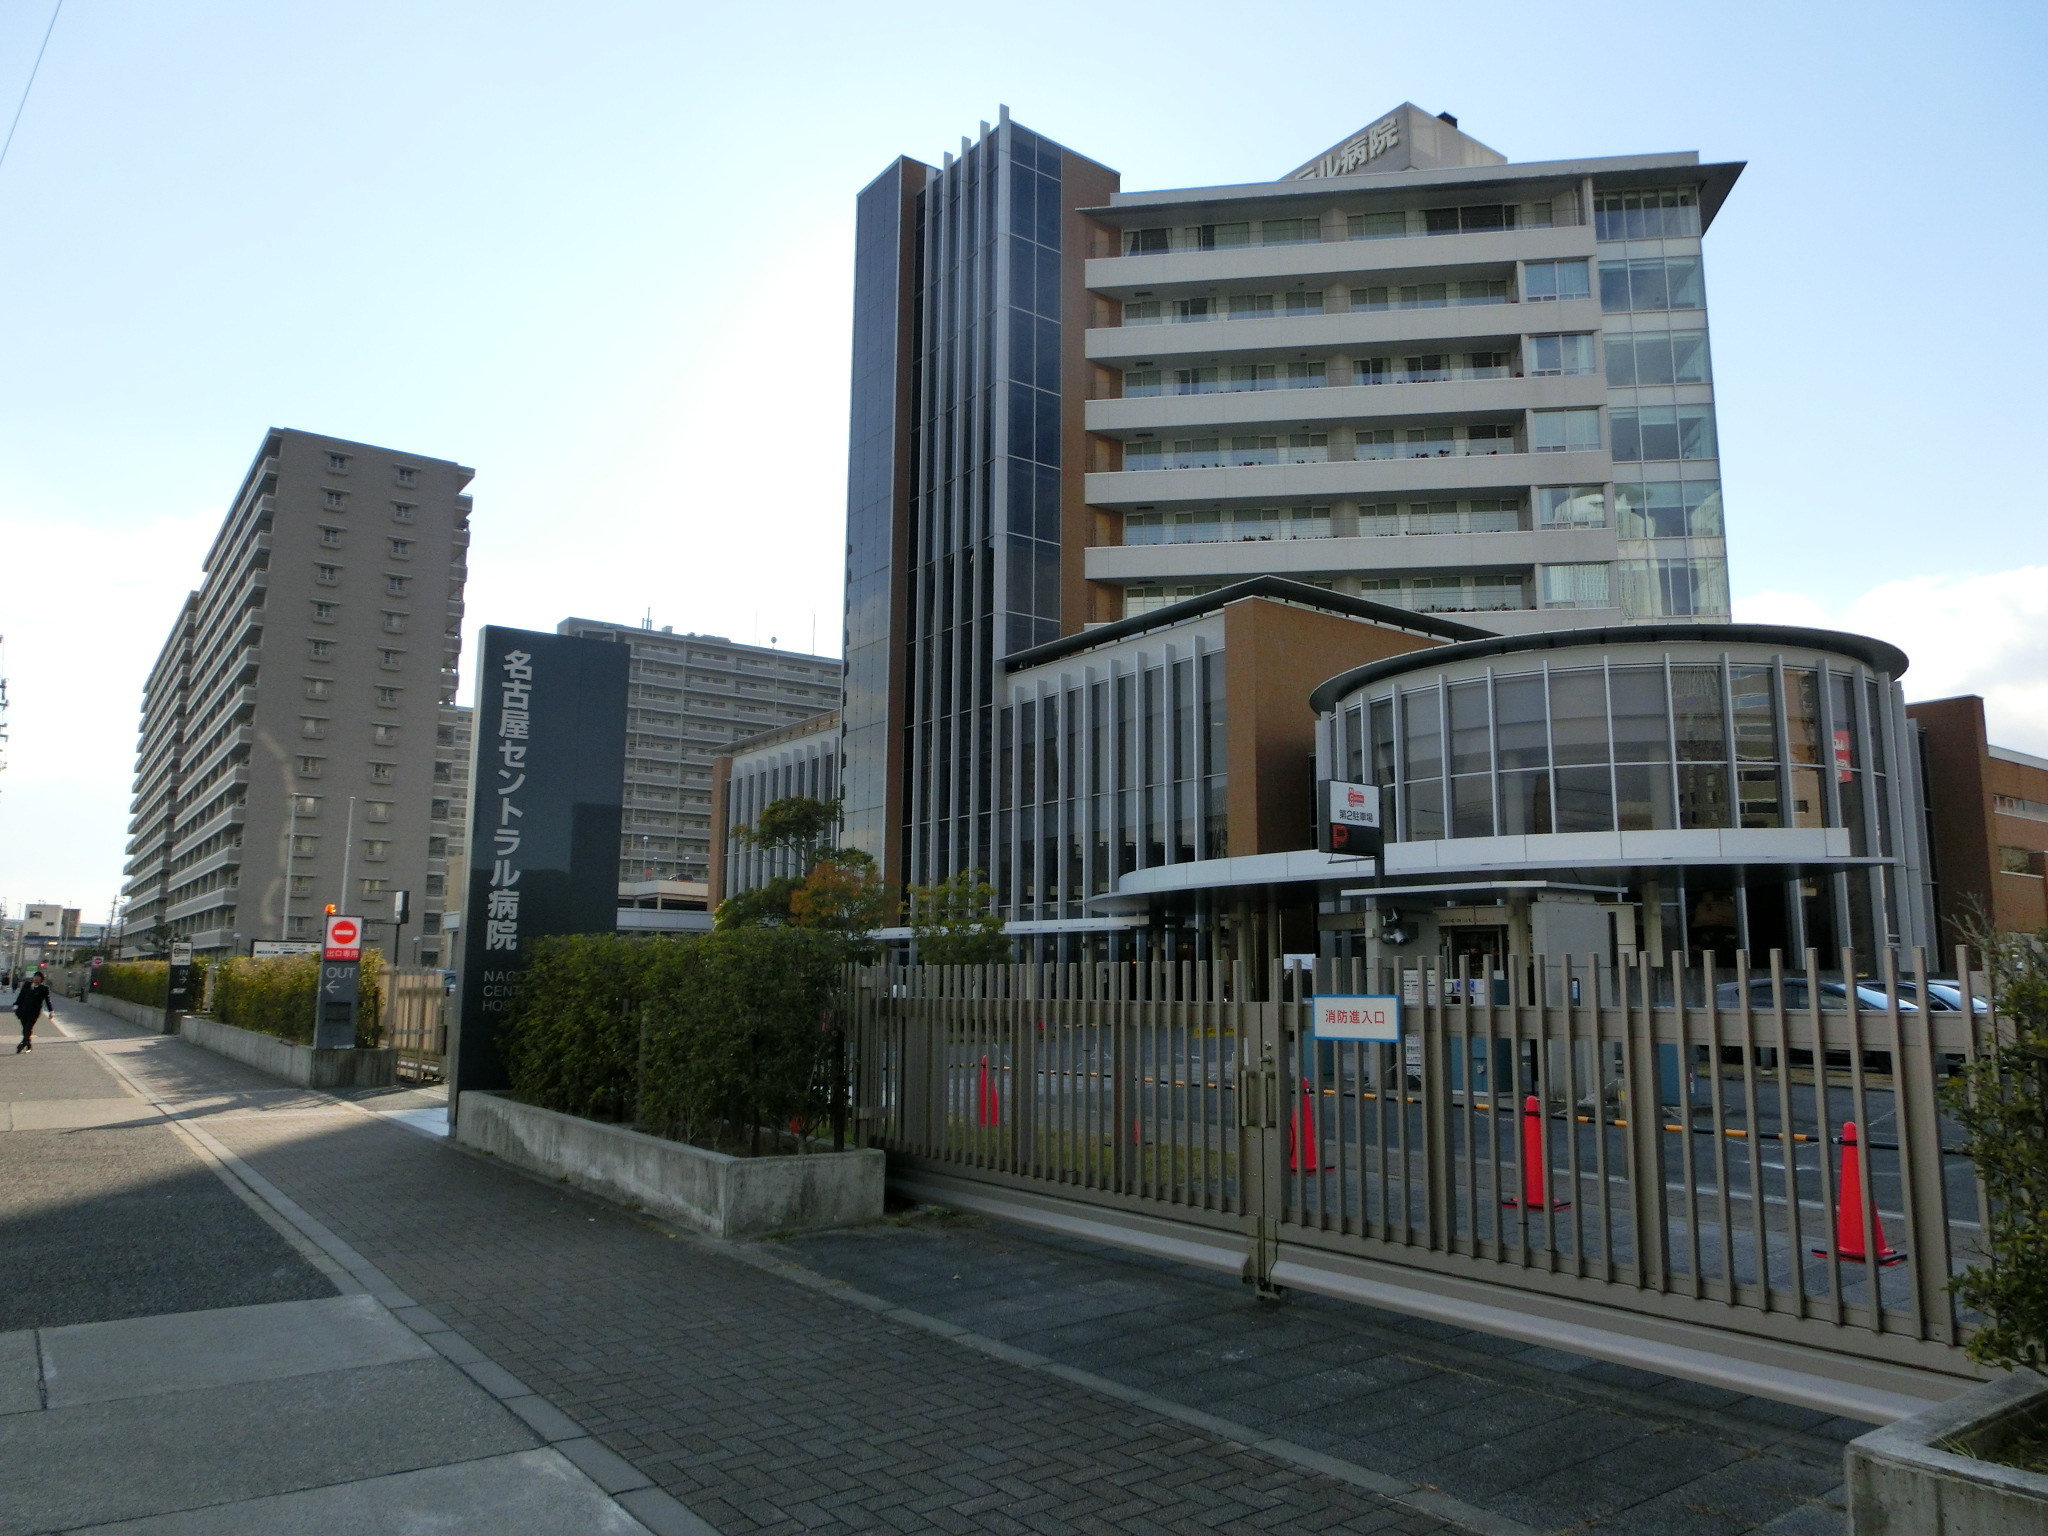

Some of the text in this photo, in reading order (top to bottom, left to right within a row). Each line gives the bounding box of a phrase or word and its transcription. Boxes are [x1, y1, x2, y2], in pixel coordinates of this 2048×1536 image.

[485, 650, 532, 951] 名古屋セントラル病院
[1332, 824, 1348, 848] P
[326, 967, 356, 979] OUT
[1325, 1009, 1385, 1024] 消防進入口
